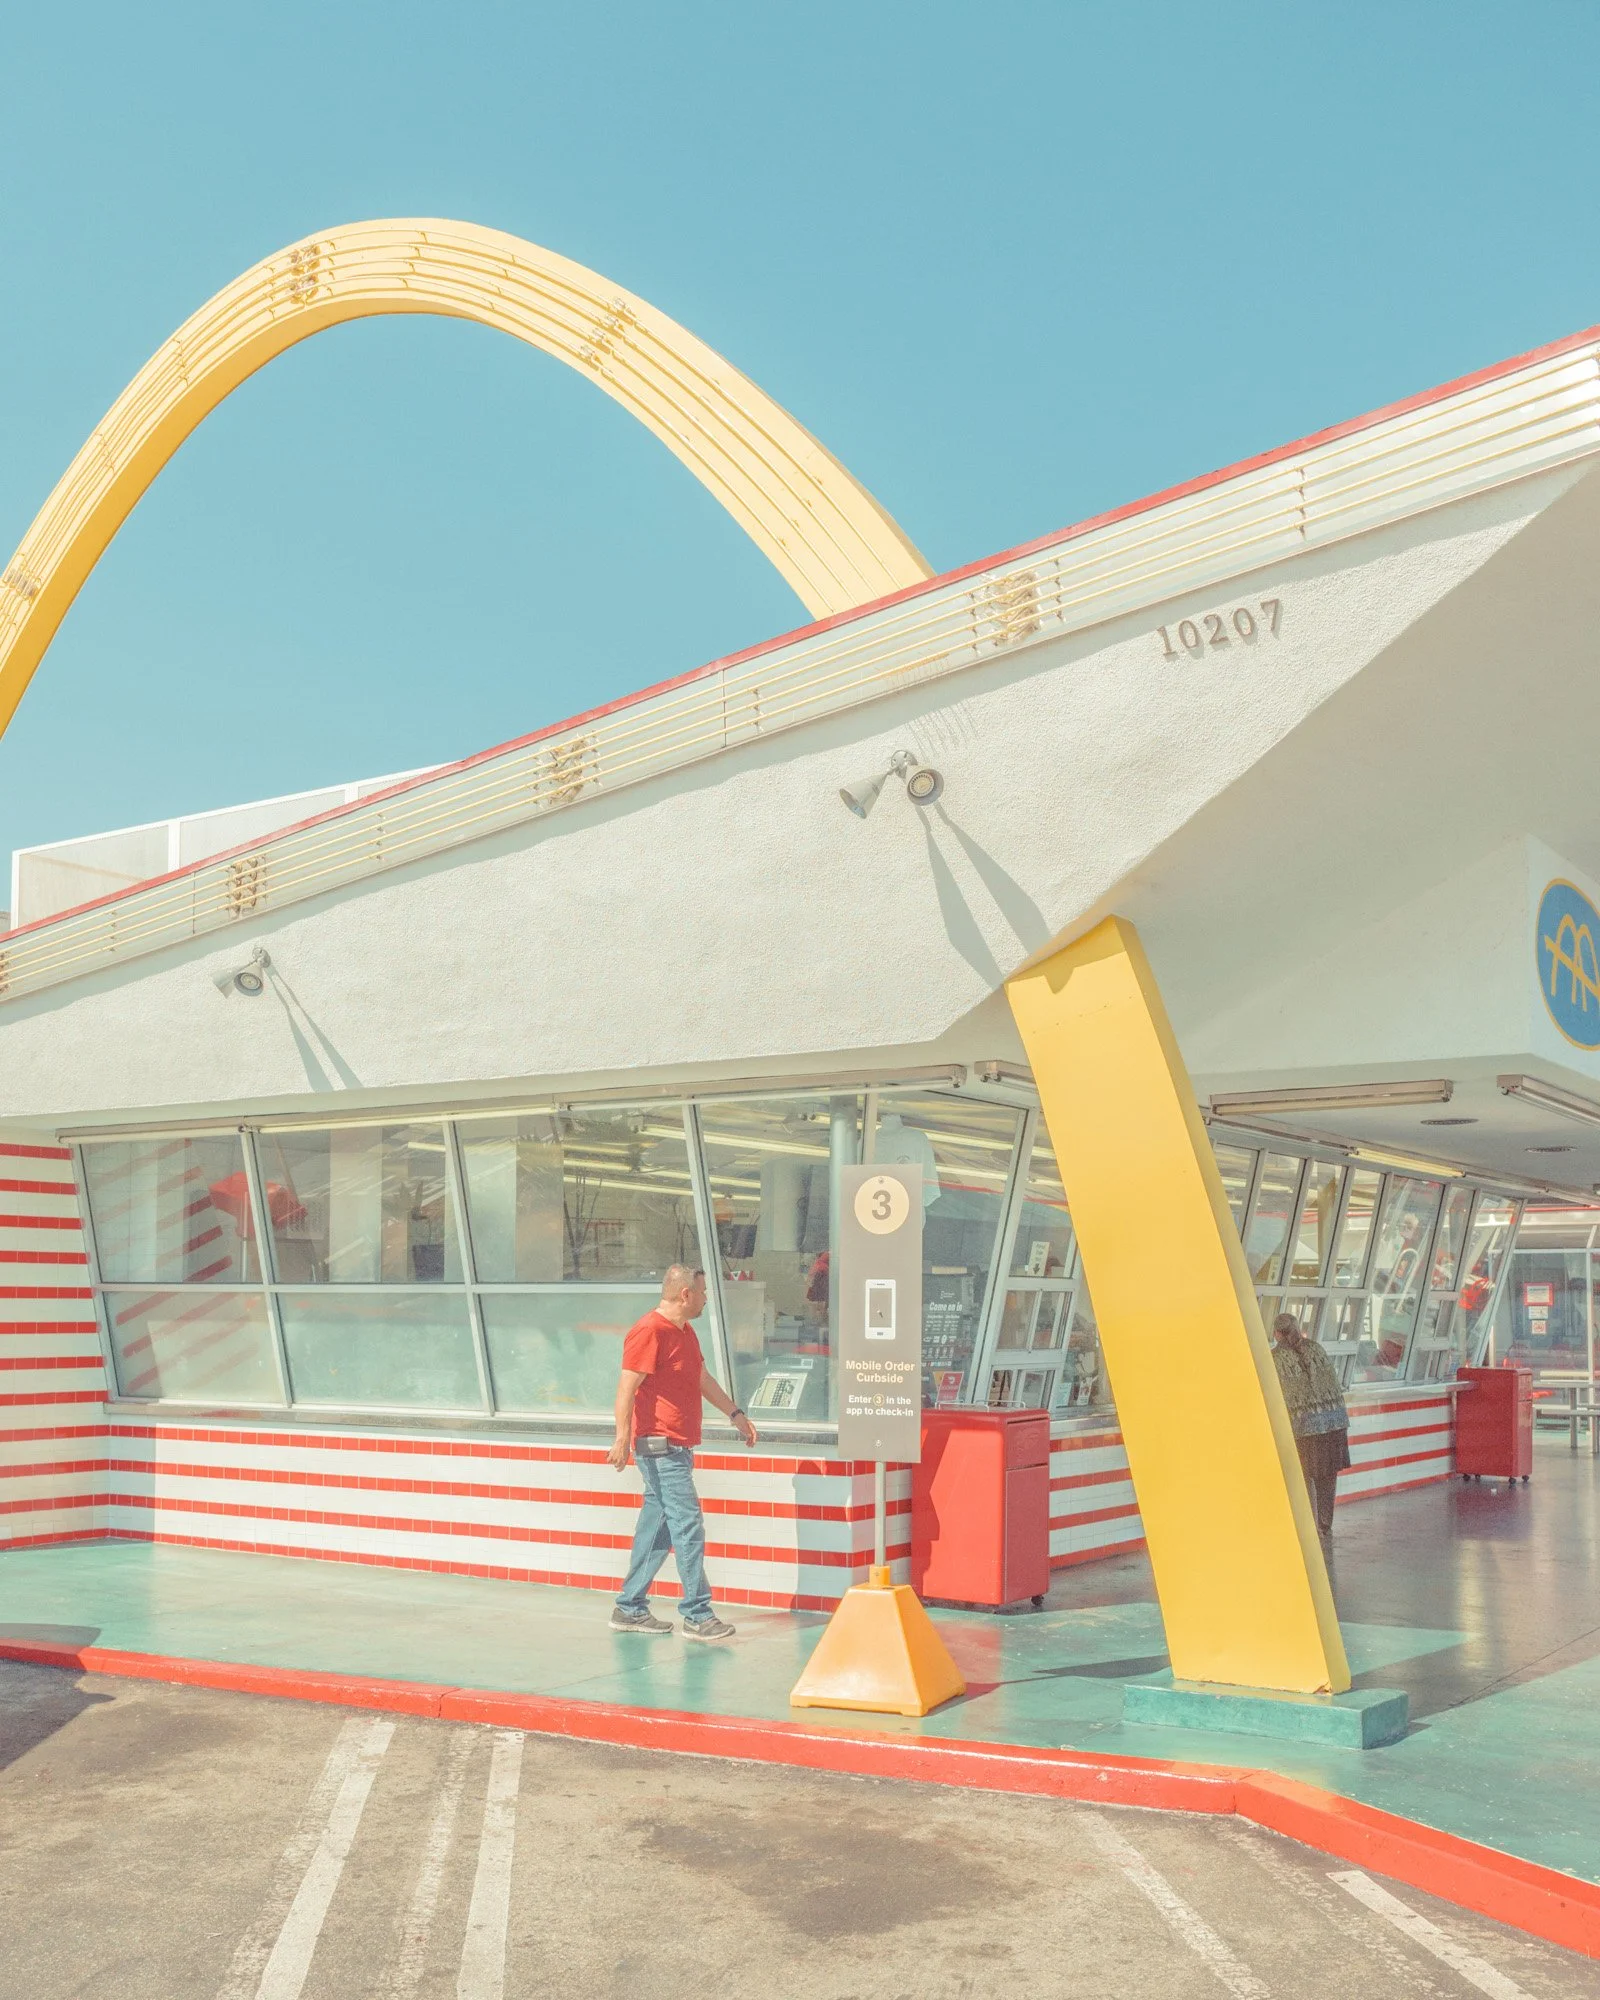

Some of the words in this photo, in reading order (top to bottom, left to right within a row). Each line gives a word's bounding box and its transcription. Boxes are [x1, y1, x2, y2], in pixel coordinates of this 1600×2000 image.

[1156, 598, 1280, 657] 10207
[871, 1189, 892, 1221] 3
[929, 1301, 947, 1311] Come
[947, 1303, 956, 1311] on
[956, 1301, 963, 1311] in
[845, 1360, 882, 1371] Mobile
[884, 1361, 915, 1371] Order
[856, 1372, 904, 1383] Curbside
[848, 1394, 872, 1404] Enter
[886, 1395, 895, 1404] in
[896, 1396, 912, 1405] the
[846, 1408, 863, 1416] app
[864, 1407, 874, 1415] to
[875, 1407, 914, 1416] check-in
